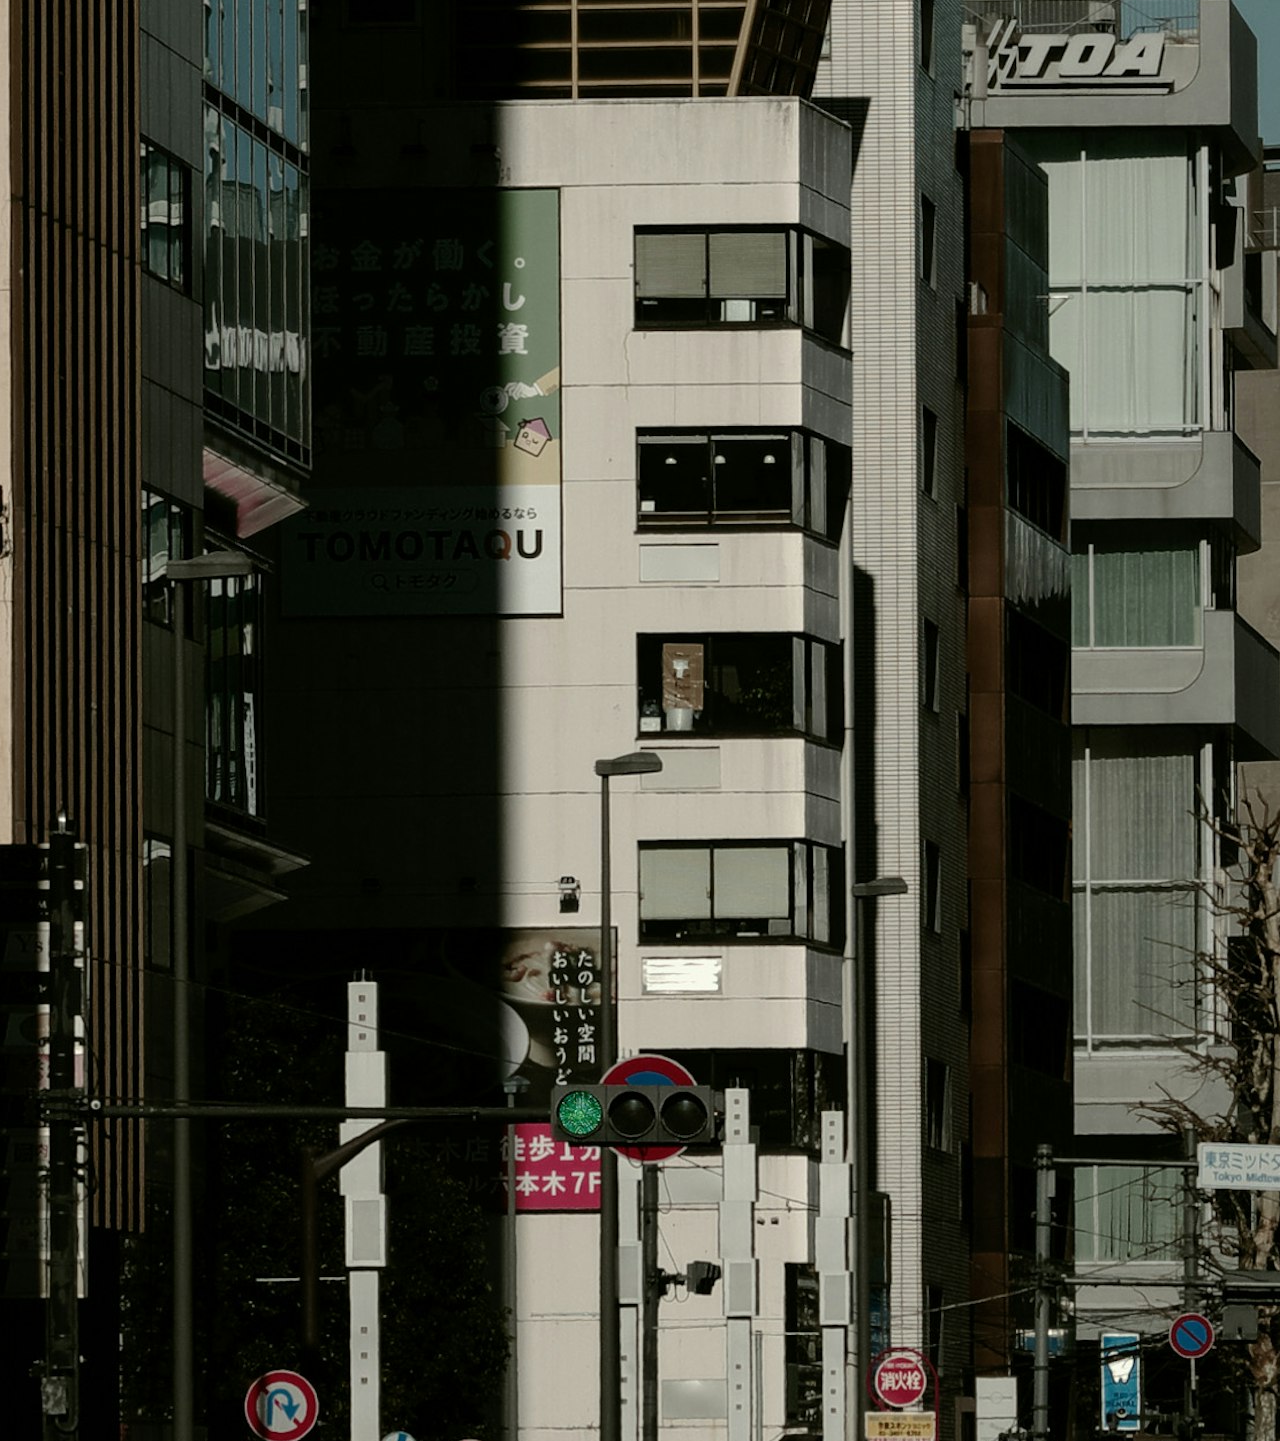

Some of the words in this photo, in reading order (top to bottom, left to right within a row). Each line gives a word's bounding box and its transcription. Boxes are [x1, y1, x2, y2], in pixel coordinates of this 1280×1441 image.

[1017, 32, 1165, 77] TOA
[312, 238, 526, 271] お金が働く。
[312, 281, 526, 315] ほったらかし
[311, 322, 529, 357] 不動産投資
[297, 529, 543, 563] TOMOTAQU
[577, 950, 597, 1065] たのしい空間
[1213, 1171, 1243, 1183] Tokyo
[880, 1370, 922, 1391] 消火栓
